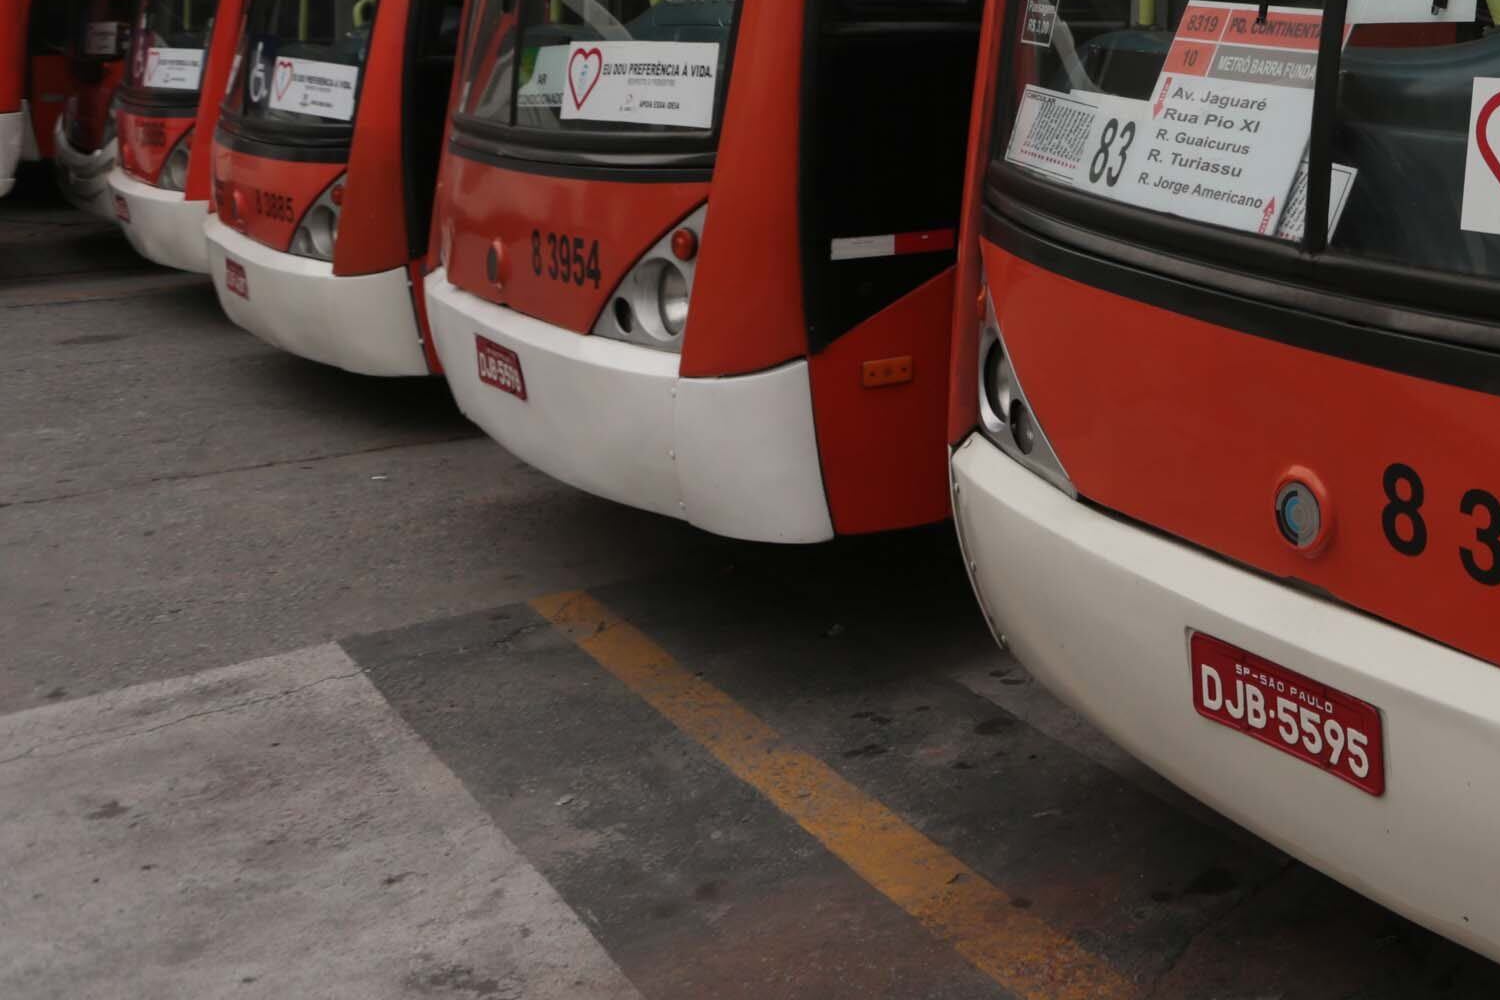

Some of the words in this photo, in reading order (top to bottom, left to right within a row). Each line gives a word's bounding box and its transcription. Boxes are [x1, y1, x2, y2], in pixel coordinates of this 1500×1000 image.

[1187, 14, 1219, 33] 8319
[629, 60, 680, 77] PREFERÊNCIA
[1184, 49, 1199, 67] 10
[1250, 58, 1283, 76] BARRA
[1171, 87, 1195, 101] Av.
[1200, 90, 1267, 111] Jaguaré
[1163, 107, 1198, 124] Rua
[1204, 113, 1234, 130] Pio
[1240, 119, 1261, 133] XI
[1089, 117, 1136, 188] 83
[1155, 128, 1169, 141] R.
[1175, 132, 1250, 155] Guaicurus
[1147, 148, 1162, 163] R.
[1170, 152, 1242, 178] Turiassu
[1137, 172, 1149, 185] R.
[1153, 176, 1190, 195] Jorge
[1191, 184, 1263, 209] Americano
[530, 228, 543, 276] 8
[547, 231, 602, 290] 3954
[1381, 462, 1428, 557] 8
[1290, 686, 1334, 714] PAULO
